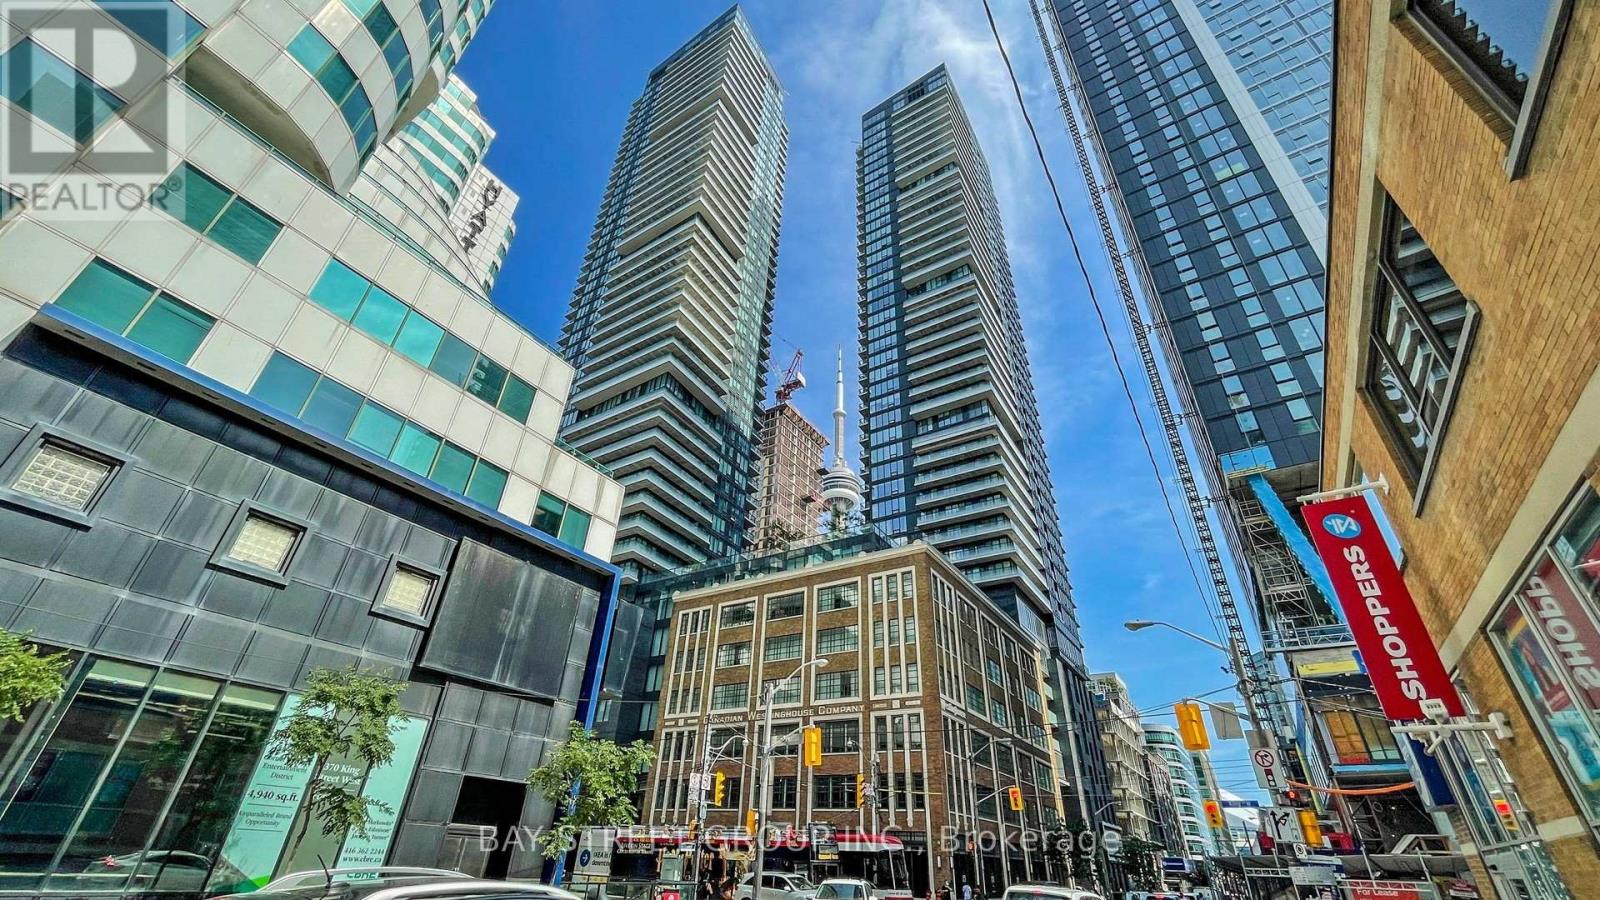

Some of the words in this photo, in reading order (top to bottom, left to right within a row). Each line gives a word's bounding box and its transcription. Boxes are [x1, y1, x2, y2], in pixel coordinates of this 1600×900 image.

[461, 179, 502, 253] HYATT
[1343, 545, 1427, 700] SHOPPERS
[748, 707, 815, 721] WESINGHOUSE
[818, 704, 865, 715] COMPANY
[324, 762, 340, 771] 370
[341, 764, 361, 776] King
[319, 773, 339, 782] treet
[342, 775, 360, 785] West
[248, 789, 275, 800] 4,940
[1356, 887, 1371, 896] For
